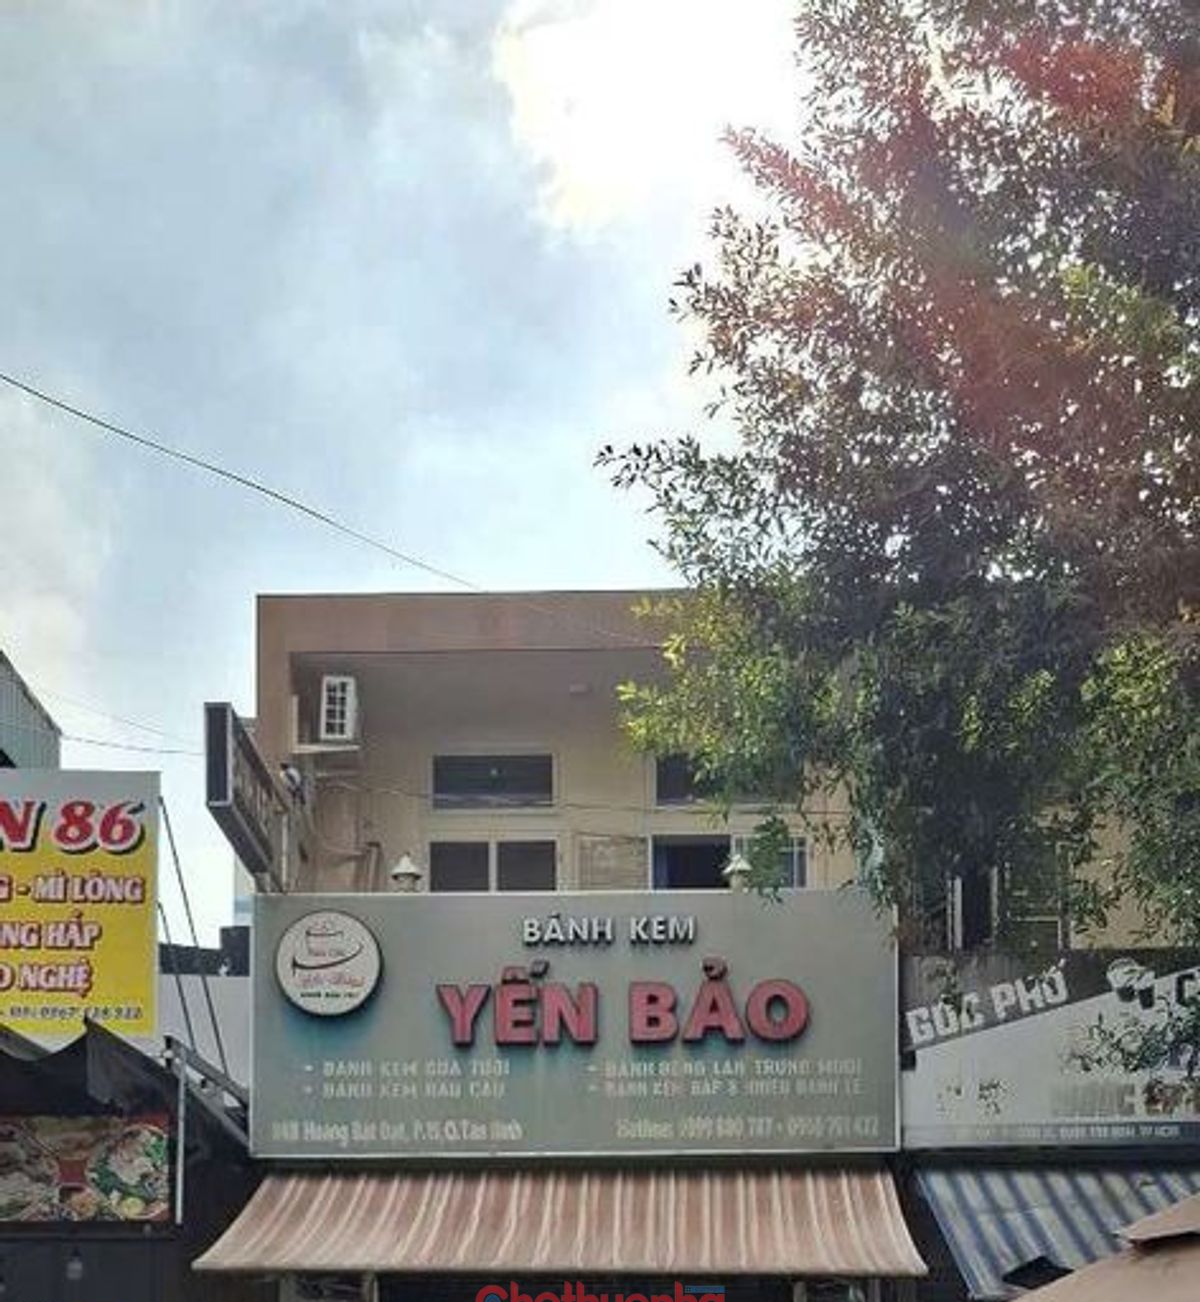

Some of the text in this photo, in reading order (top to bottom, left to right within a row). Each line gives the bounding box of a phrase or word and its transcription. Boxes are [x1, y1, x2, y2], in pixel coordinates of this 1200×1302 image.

[54, 800, 145, 854] 86
[71, 868, 145, 903] LÒNG
[523, 912, 697, 945] BÁNH KEM
[19, 957, 93, 997] NGHỆ
[436, 957, 810, 1045] YẾN BẢO
